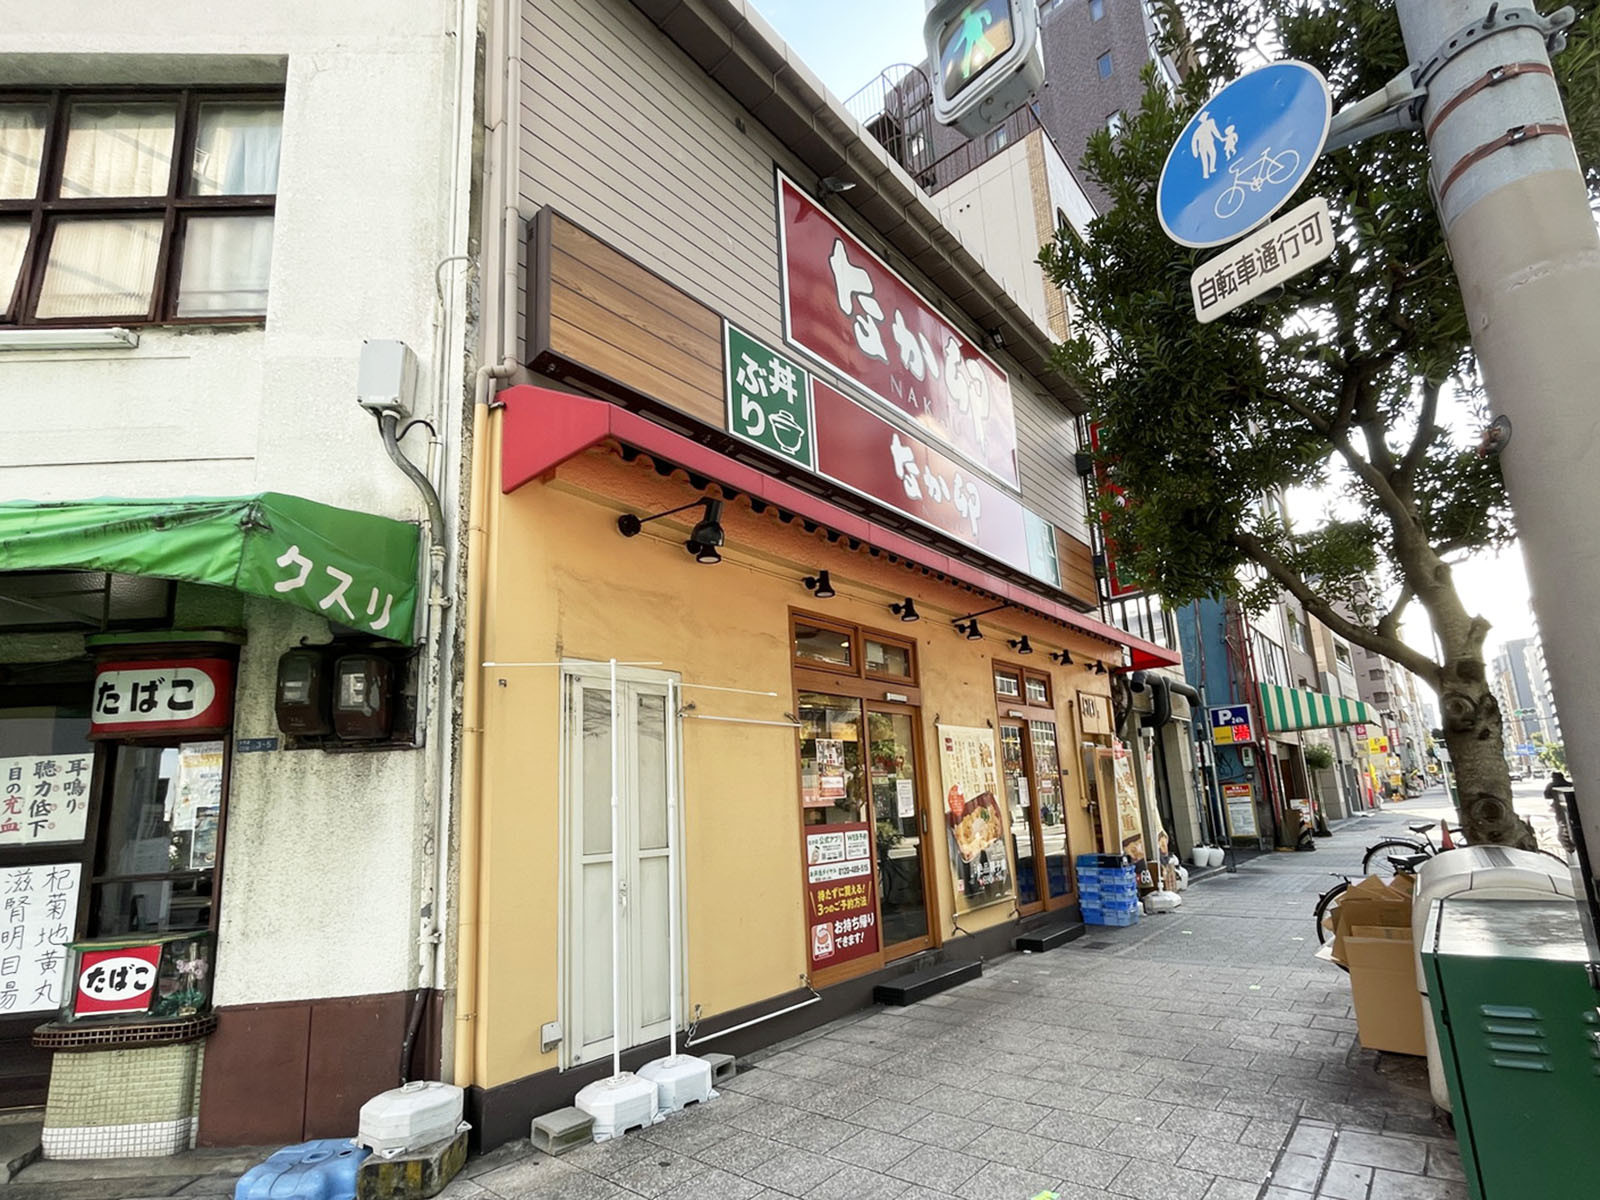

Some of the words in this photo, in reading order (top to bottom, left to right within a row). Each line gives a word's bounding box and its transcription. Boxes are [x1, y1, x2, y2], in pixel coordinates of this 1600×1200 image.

[1199, 212, 1323, 310] 自転車通行可
[830, 239, 988, 455] なか卯
[890, 433, 981, 538] なか卯
[276, 545, 393, 631] クスリ
[95, 677, 195, 714] たばこ
[1218, 710, 1232, 724] P
[0, 767, 23, 834] 目の充血
[28, 760, 57, 838] 聴力低下
[63, 758, 88, 815] 耳鳴り
[31, 867, 73, 1004] 杞菊地黄丸
[834, 912, 875, 934] お持ち帰り
[835, 932, 864, 948] できます!
[86, 963, 149, 993] たばこ
